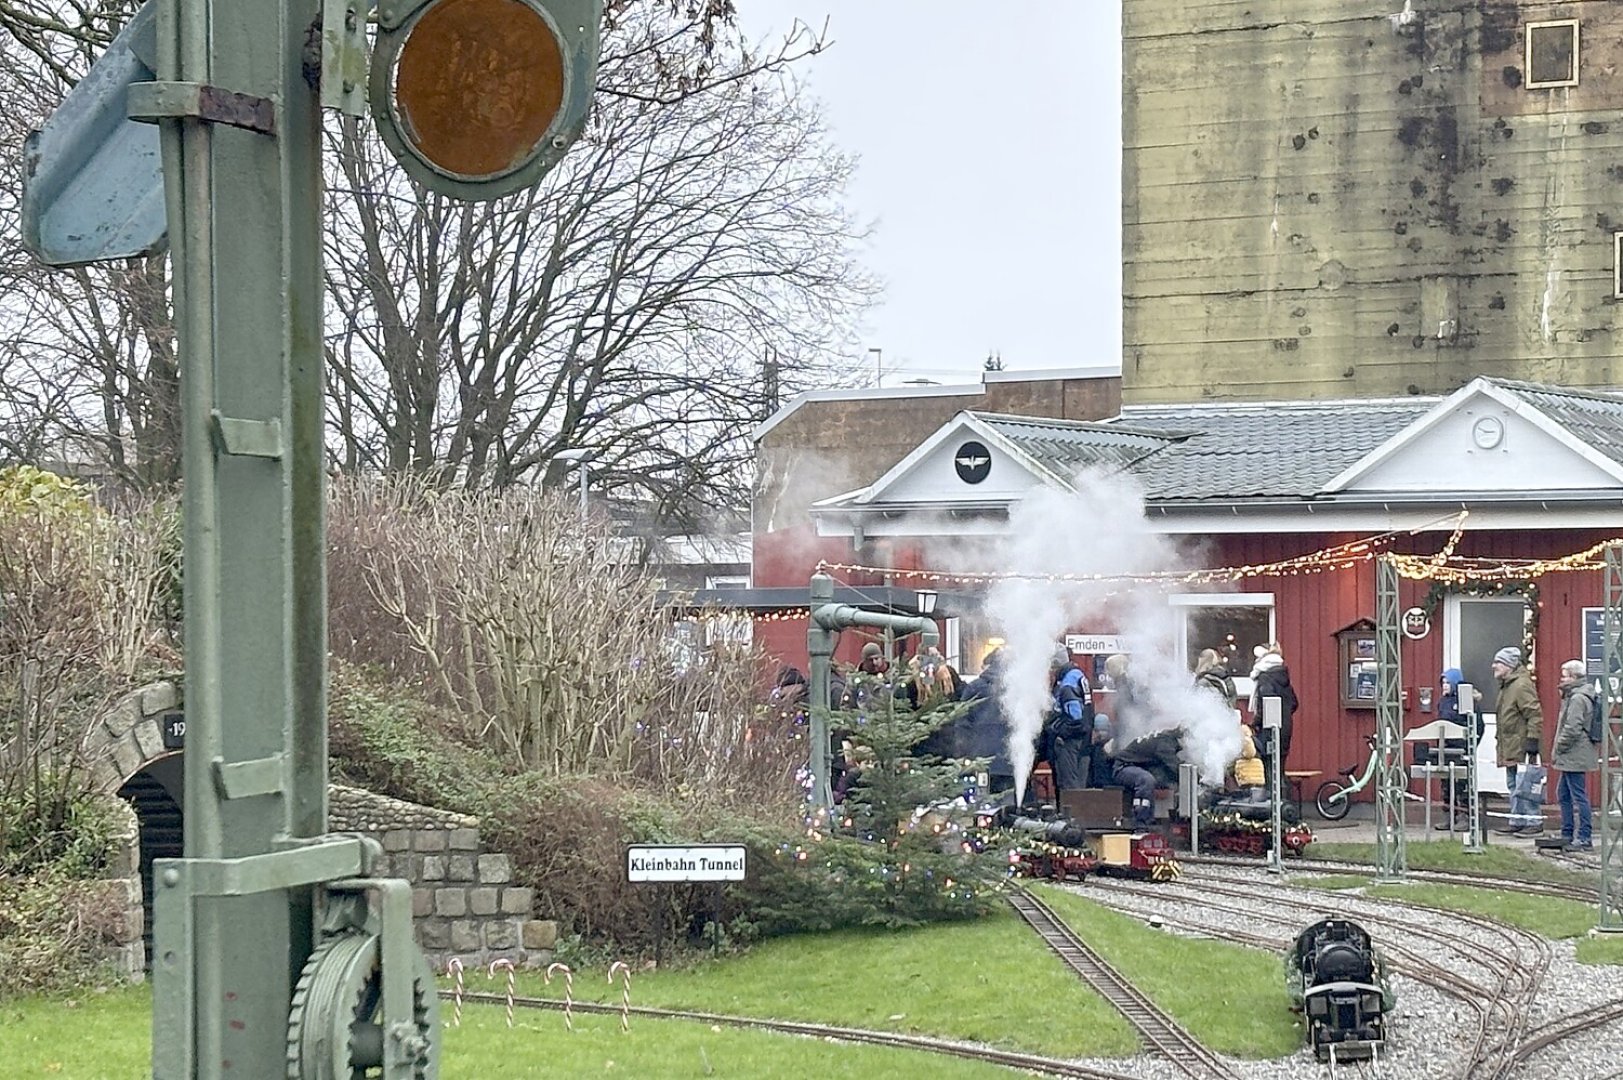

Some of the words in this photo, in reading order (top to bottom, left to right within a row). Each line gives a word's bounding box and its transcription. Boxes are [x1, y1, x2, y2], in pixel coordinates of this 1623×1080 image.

[1067, 638, 1105, 650] Emden
[172, 722, 186, 736] 19
[631, 857, 696, 871] Kleinbahn
[699, 857, 743, 871] Tunnel
